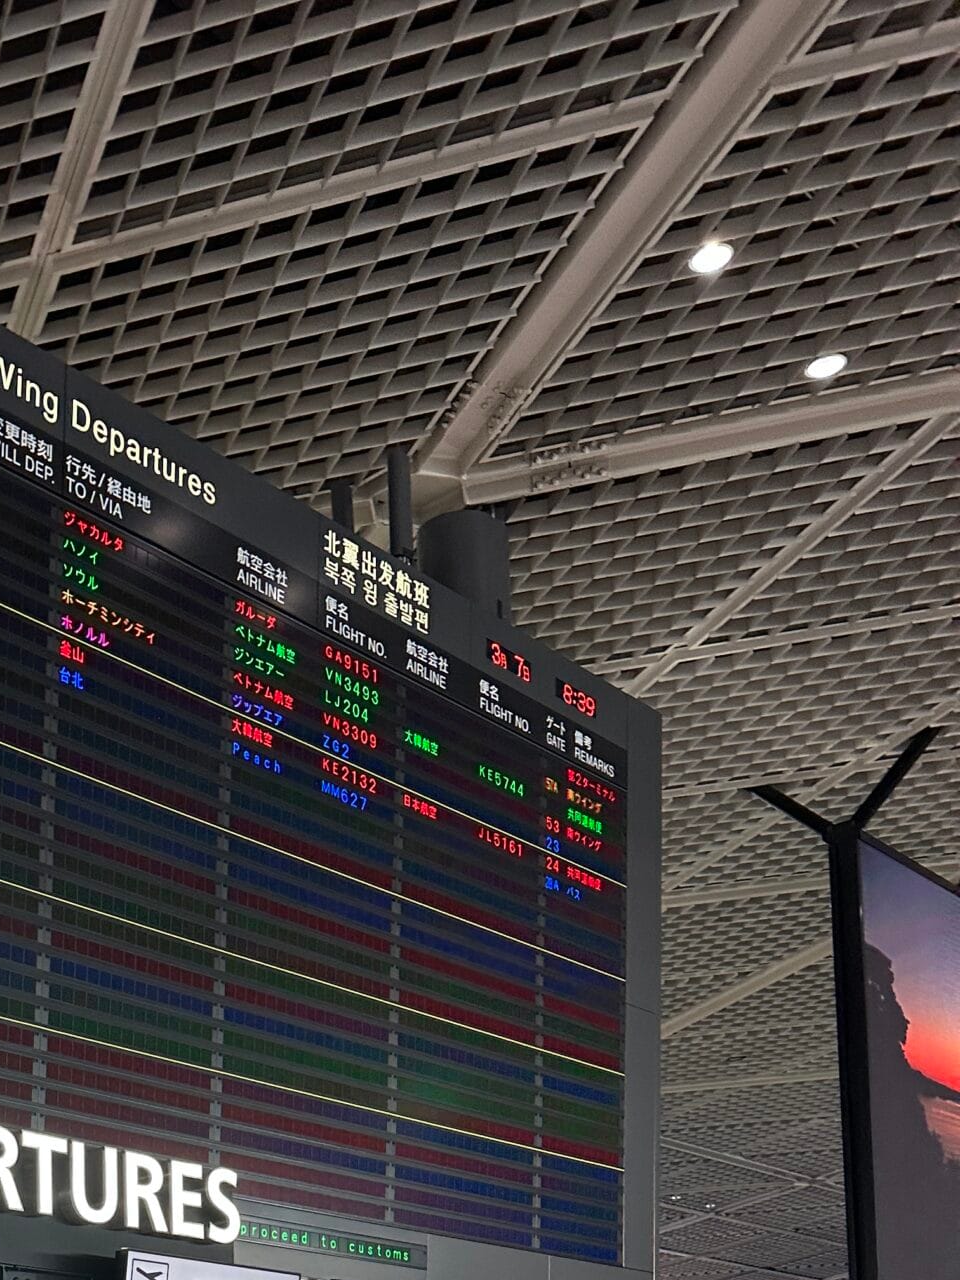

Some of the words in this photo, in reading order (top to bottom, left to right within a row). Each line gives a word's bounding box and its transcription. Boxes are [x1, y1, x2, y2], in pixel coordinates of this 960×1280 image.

[71, 399, 217, 505] Departures
[25, 457, 56, 485] DEP.
[63, 511, 124, 551] ジャカルタ
[63, 538, 98, 565] ハノイ
[237, 547, 288, 588] 航空会社
[62, 563, 99, 591] ソウル
[237, 569, 285, 605] AIRLINE
[61, 588, 158, 645] ホーチミンシティ
[235, 600, 277, 630] ガルーダ
[326, 595, 349, 622] 便名
[60, 614, 110, 648] ホノルル
[326, 614, 366, 648] FLIGHT
[368, 638, 387, 660] NO.
[234, 647, 285, 678] ジンエアー
[325, 645, 378, 683] GA9151
[406, 638, 449, 675] 航空会社
[491, 643, 507, 670] 3月
[514, 655, 530, 682] 7日
[58, 666, 84, 690] 台北
[325, 667, 380, 706] VN3493
[406, 661, 447, 691] AIRLINE
[479, 678, 499, 702] 便名
[325, 690, 369, 723] LJ204
[480, 698, 513, 725] FLIGHT
[515, 716, 531, 735] NO.
[323, 712, 378, 749] VN3309
[545, 714, 567, 737] ゲート
[546, 731, 566, 753] GATE
[232, 741, 282, 774] Peach
[322, 734, 350, 760] ZG2
[574, 746, 616, 778] REMARKS
[322, 757, 378, 795] KE2132
[479, 765, 525, 797] KE5744
[321, 779, 368, 812] MM627
[478, 826, 522, 857] JL5161
[546, 816, 559, 834] 53
[546, 856, 559, 873] 24
[239, 1222, 309, 1245] proceed
[320, 1235, 337, 1249] to
[349, 1241, 409, 1262] customs
